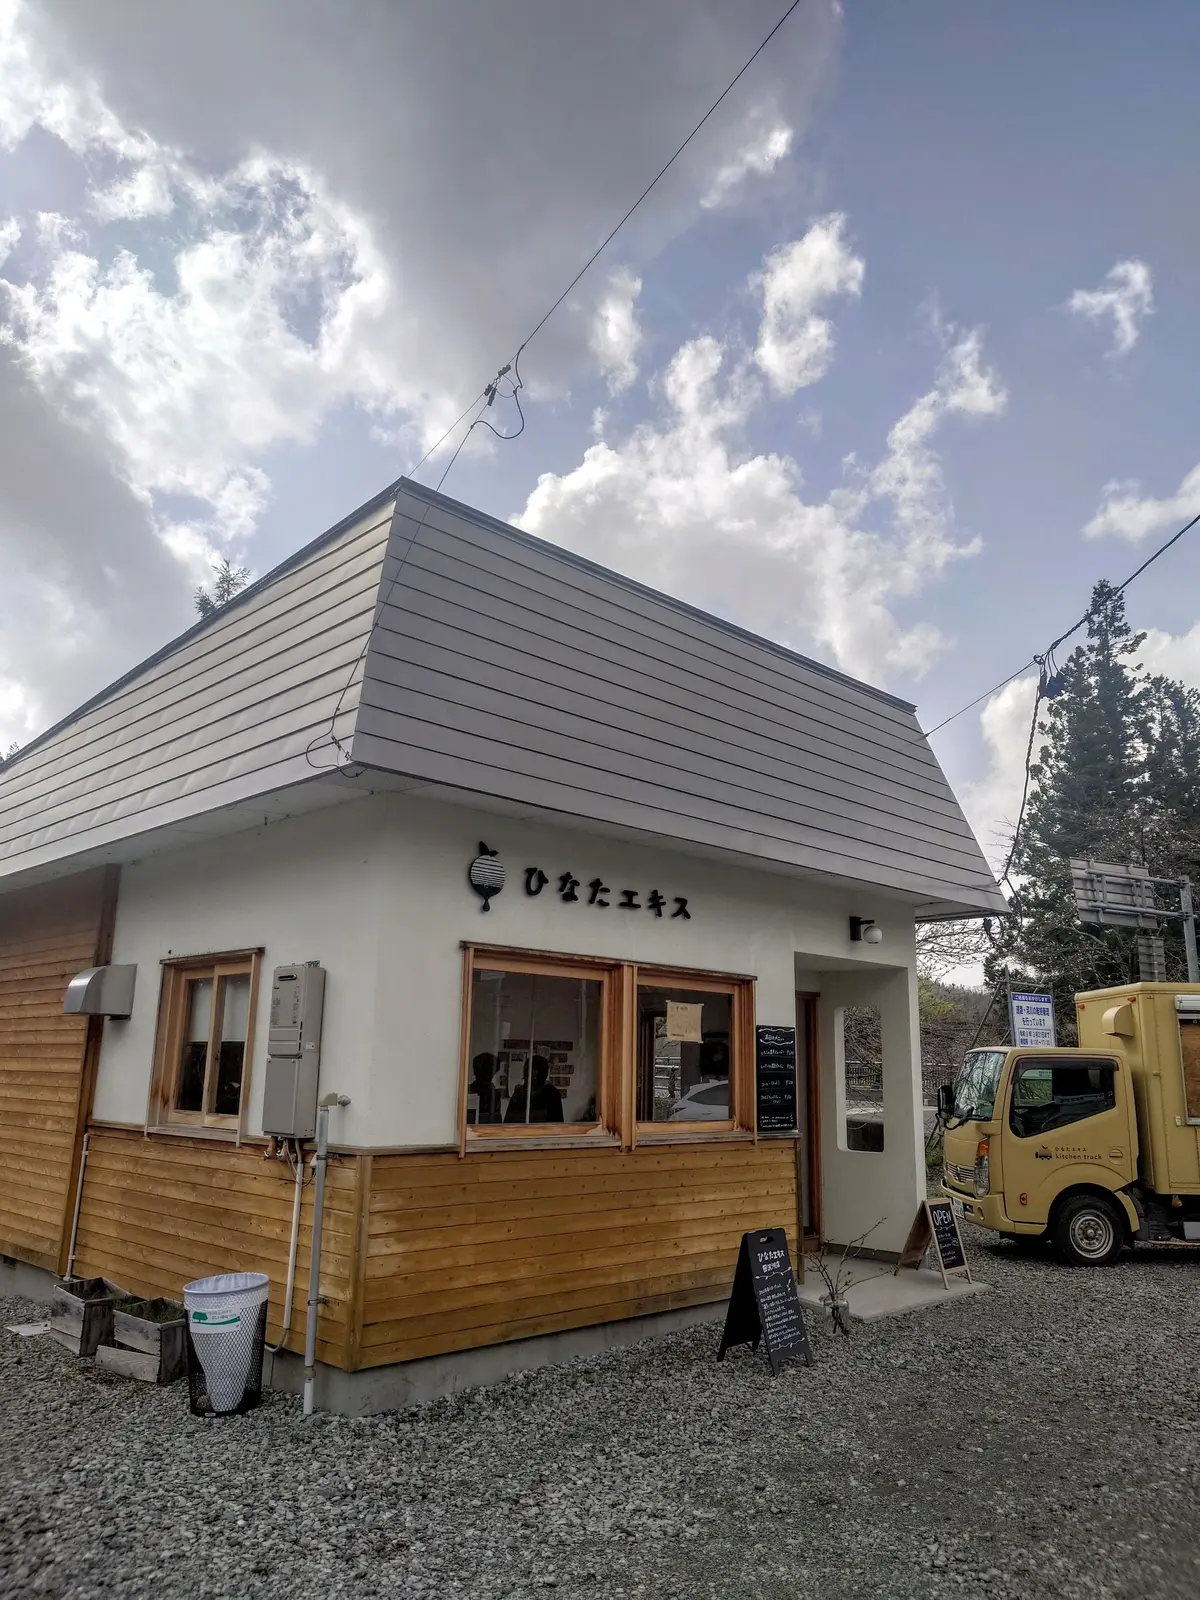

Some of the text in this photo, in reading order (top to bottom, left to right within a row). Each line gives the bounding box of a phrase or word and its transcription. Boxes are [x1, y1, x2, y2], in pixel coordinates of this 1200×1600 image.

[525, 867, 691, 919] ひなたエキス
[1055, 1152, 1082, 1160] kitchen
[932, 1209, 952, 1226] OPEN
[757, 1249, 786, 1263] ひなたエキス
